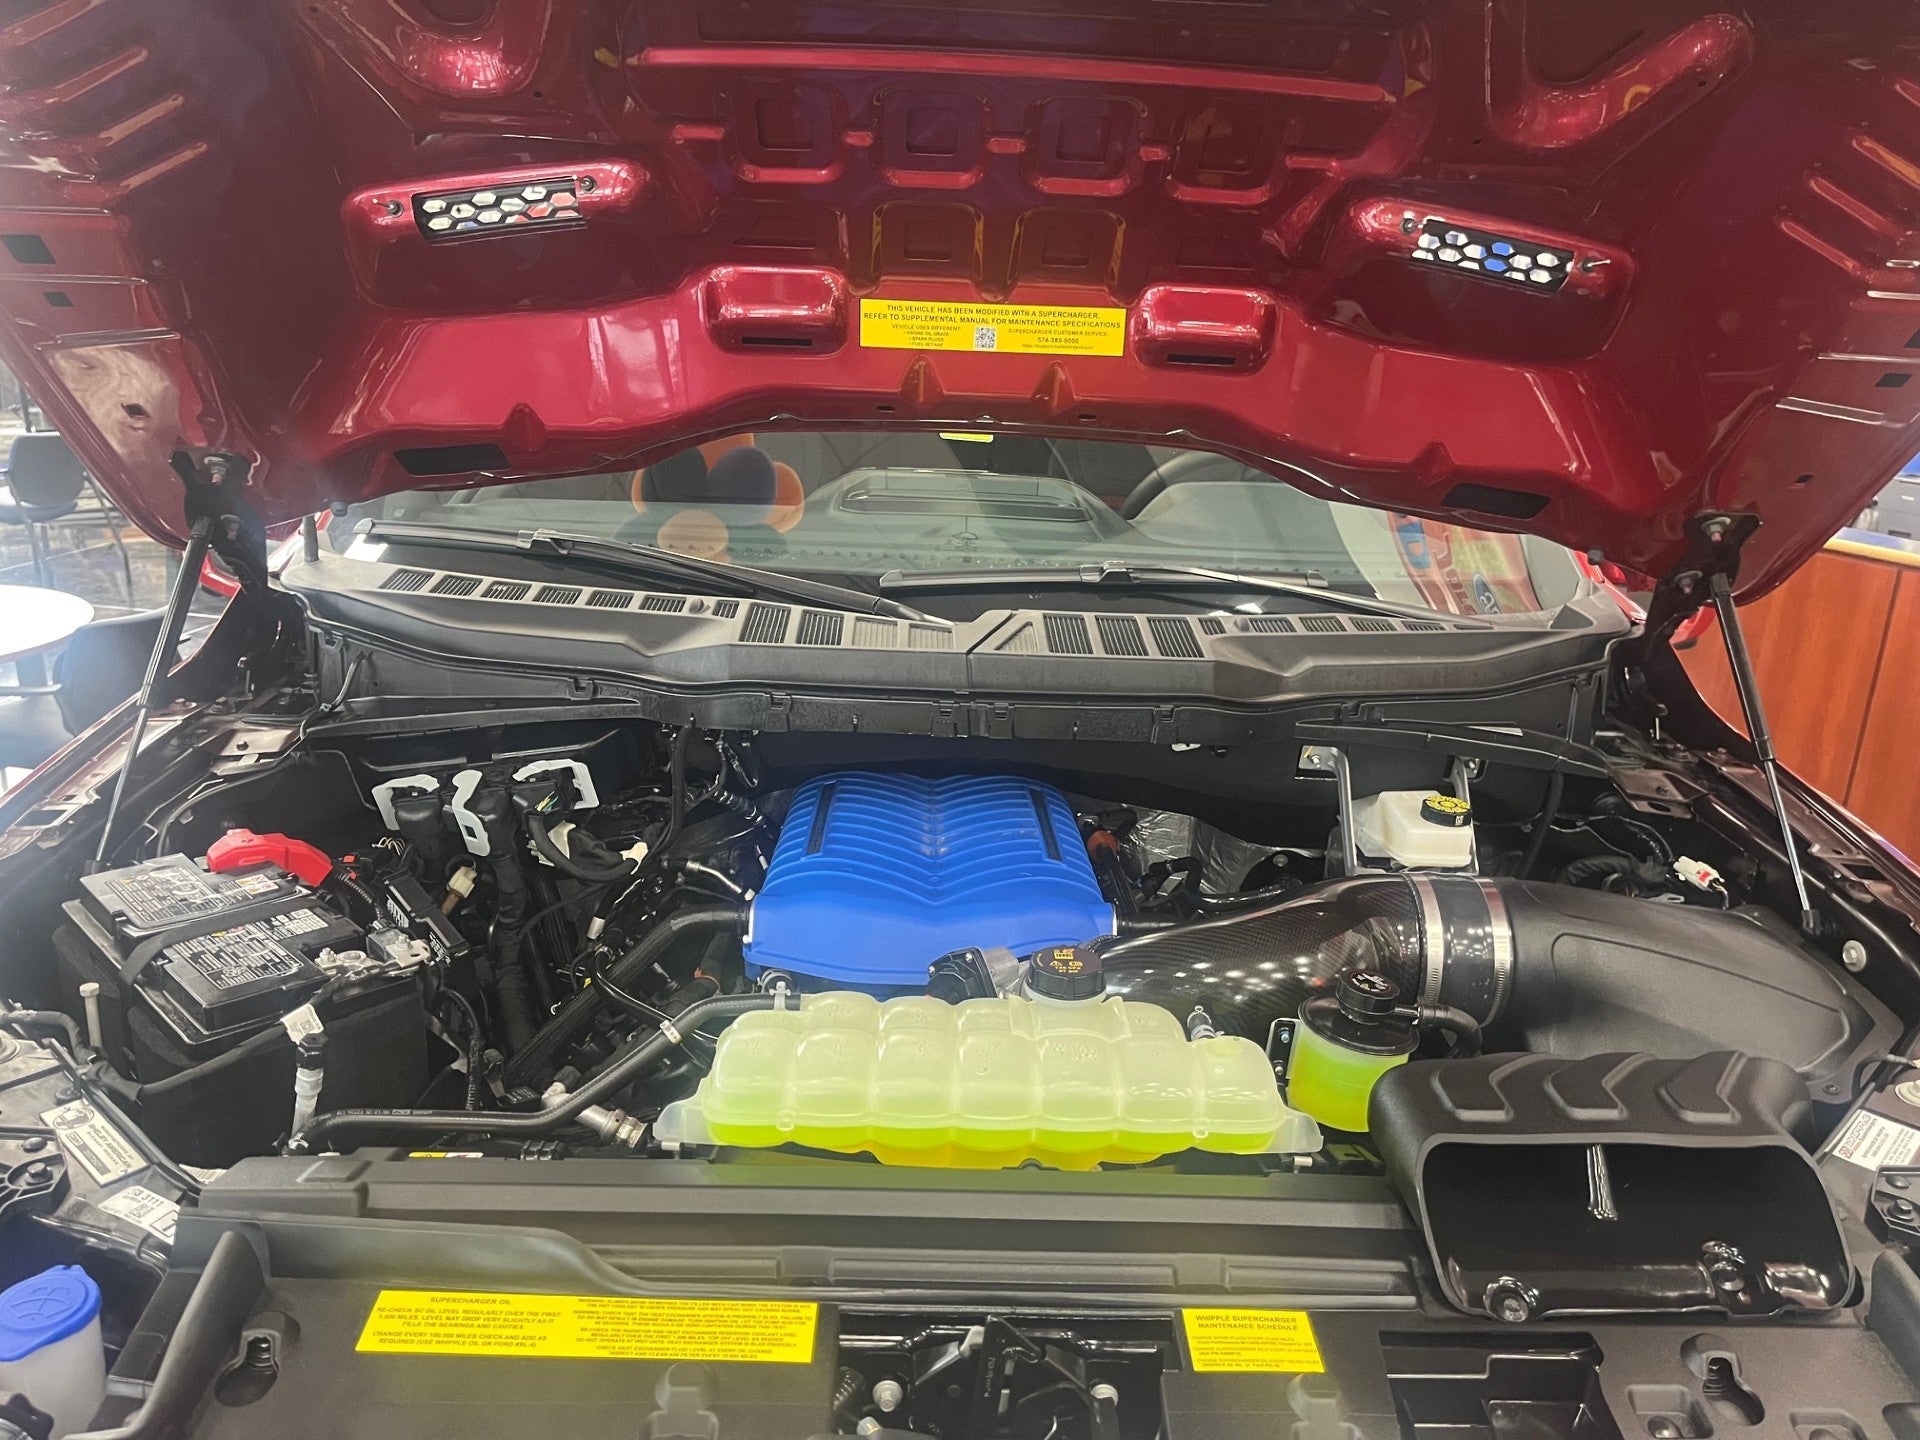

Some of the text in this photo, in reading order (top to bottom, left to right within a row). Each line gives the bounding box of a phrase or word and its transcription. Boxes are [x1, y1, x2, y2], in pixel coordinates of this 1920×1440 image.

[902, 314, 958, 323] SUPPLEMENTAL
[960, 316, 990, 324] MANUAL
[1008, 318, 1060, 326] MAINTENANCE
[1039, 310, 1100, 319] SUPERCHARGER.
[87, 1122, 109, 1143] SHELBY
[103, 1140, 134, 1169] AMERICAN
